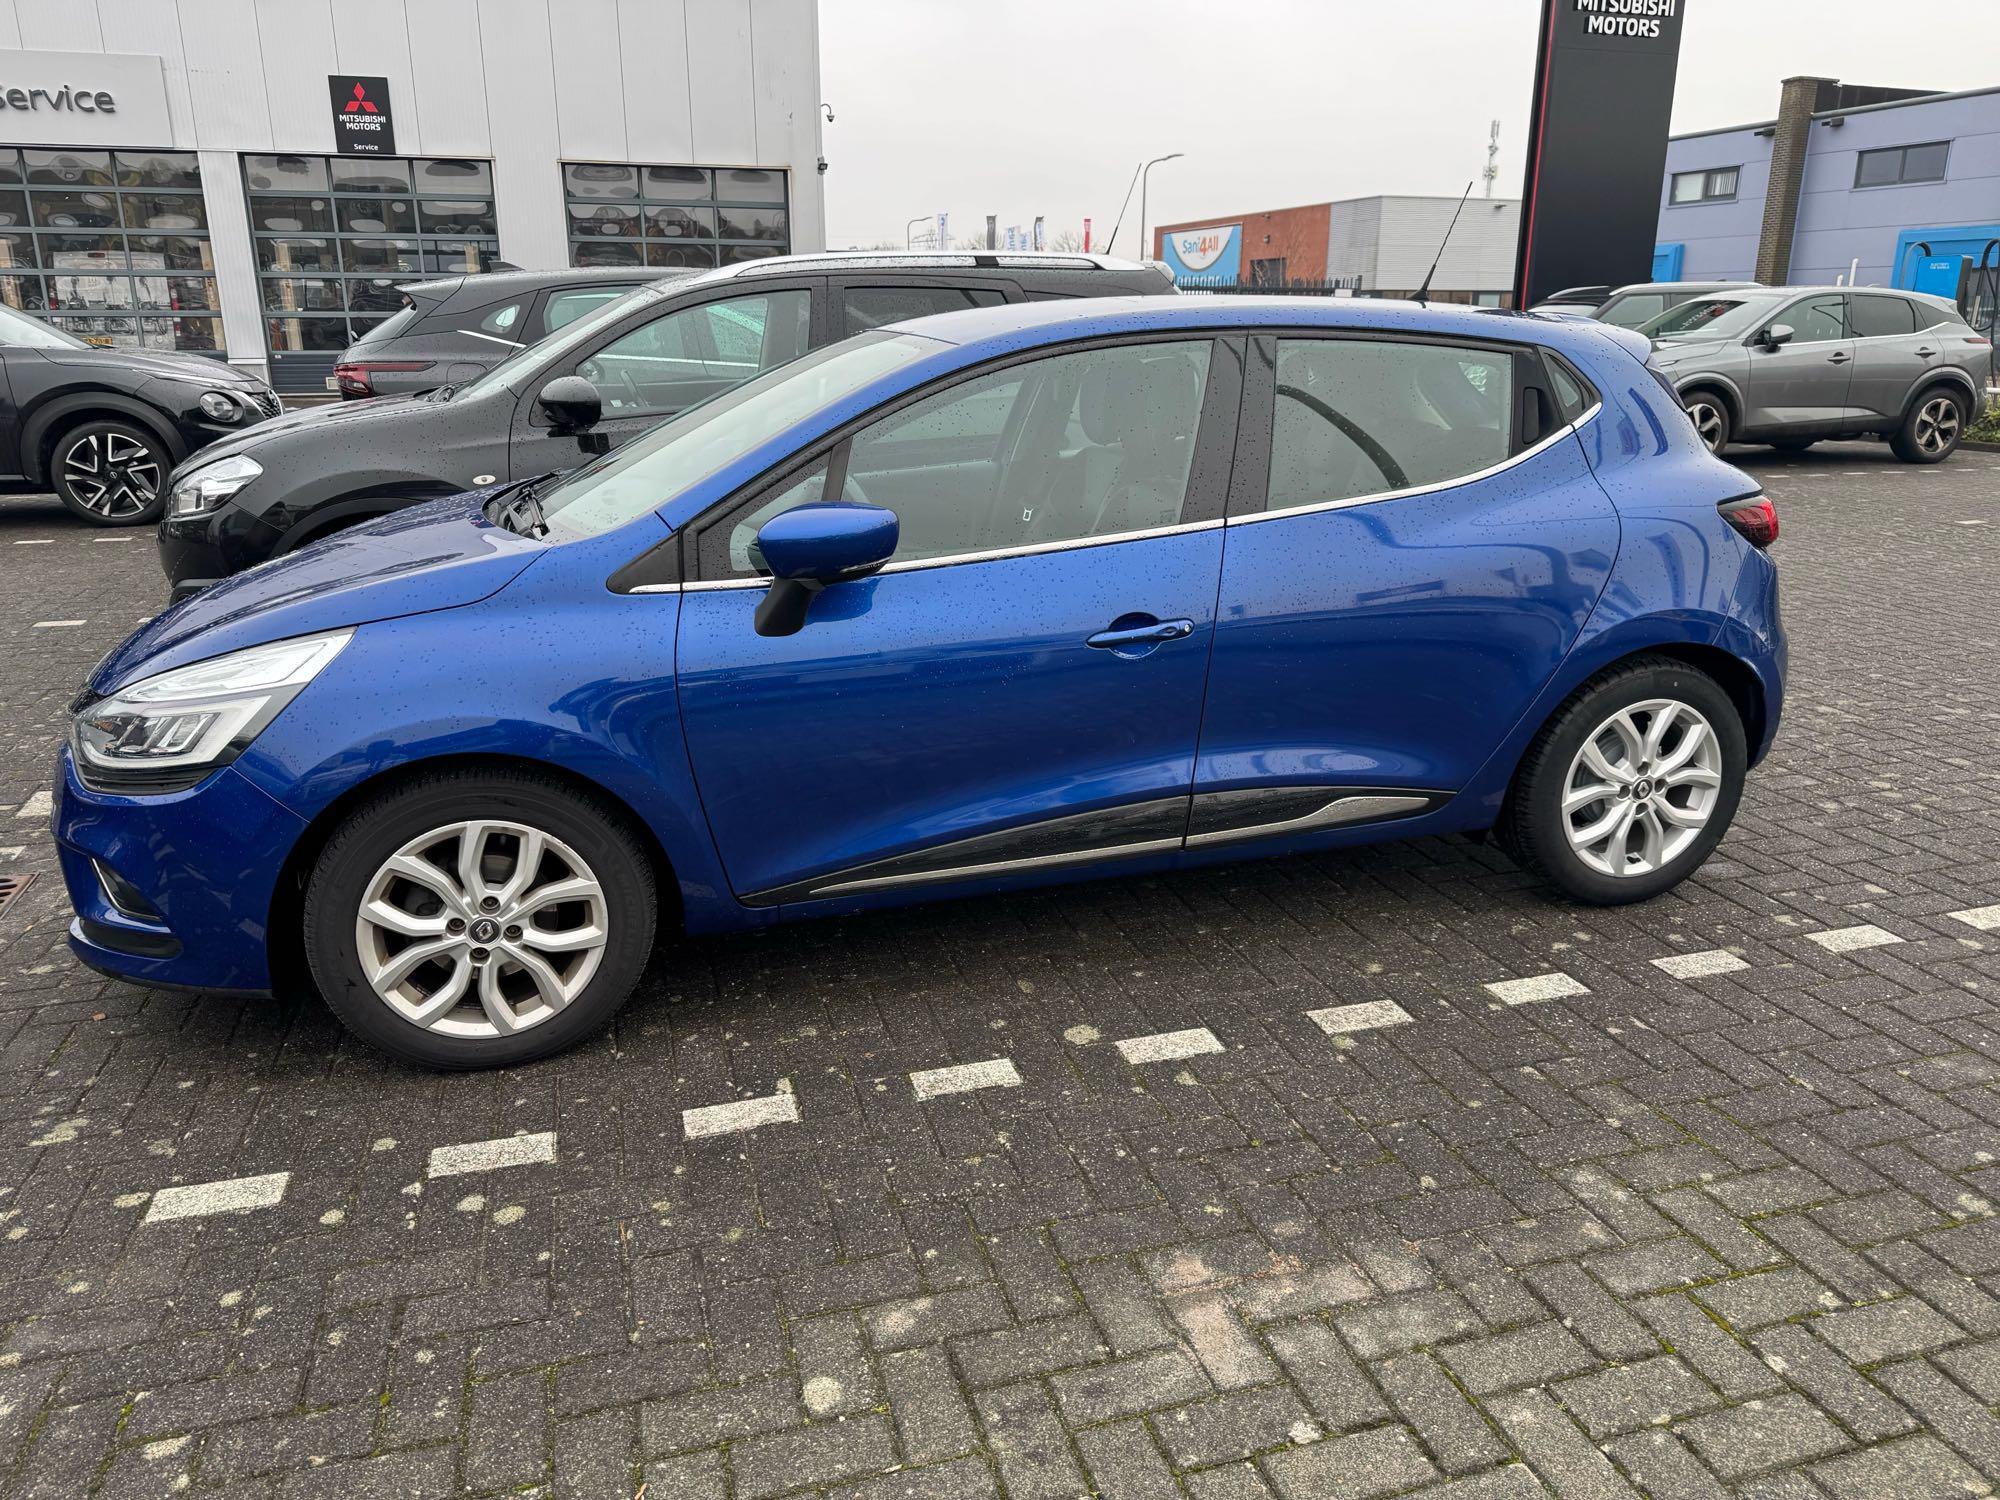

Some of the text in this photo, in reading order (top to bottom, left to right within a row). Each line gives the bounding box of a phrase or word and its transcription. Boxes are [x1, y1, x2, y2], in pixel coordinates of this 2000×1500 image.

[1577, 0, 1675, 16] MITSUBISHI
[1587, 15, 1660, 38] MOTORS
[339, 114, 386, 123] MITSUBISHI
[346, 123, 381, 131] MOTORS
[353, 143, 379, 151] Service
[1182, 235, 1219, 256] Sani4All
